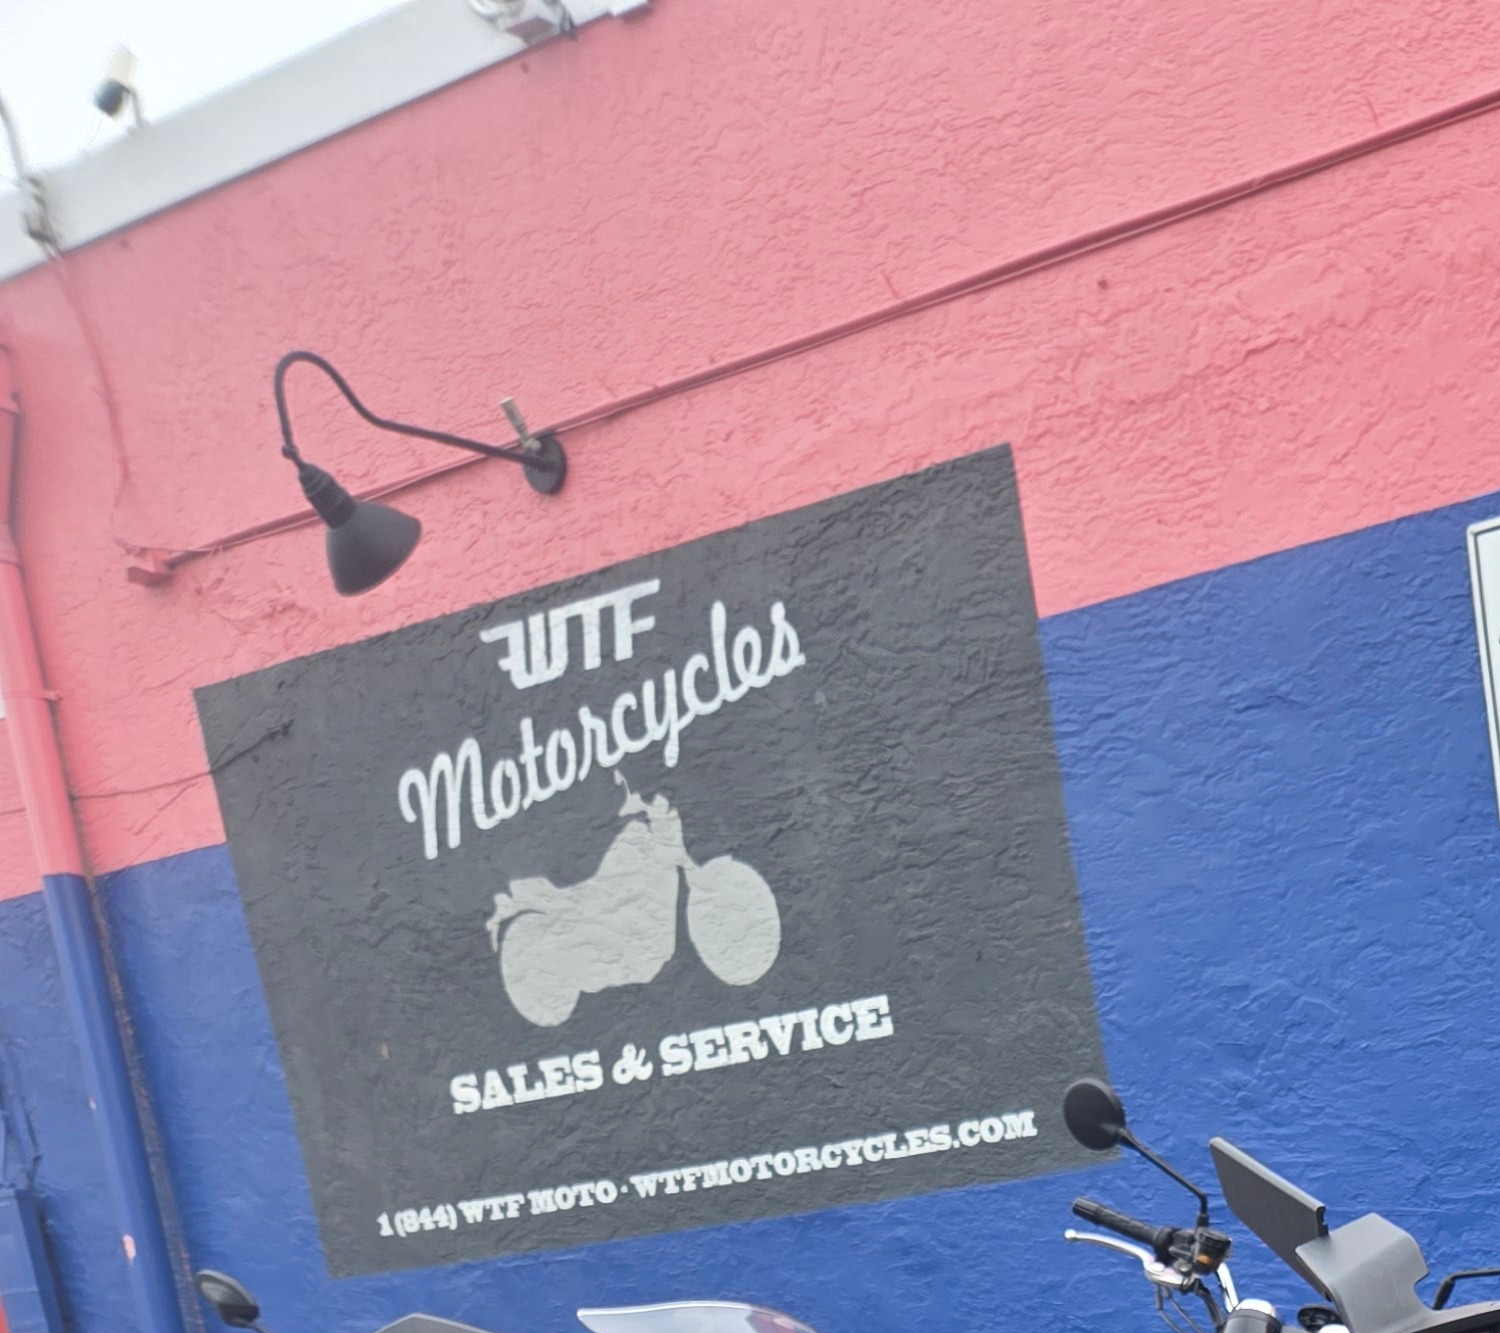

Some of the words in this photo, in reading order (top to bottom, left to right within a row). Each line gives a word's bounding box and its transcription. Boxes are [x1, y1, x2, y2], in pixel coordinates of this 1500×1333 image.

[479, 578, 661, 690] WTF
[398, 600, 806, 860] Motorcycles
[449, 1049, 605, 1115] SALES
[612, 1043, 654, 1085] &
[659, 994, 895, 1077] SERVICE
[457, 1192, 526, 1225] WTF
[526, 1180, 619, 1216] MOTO
[628, 1110, 1038, 1199] WTFMOTORCYCLES.COM
